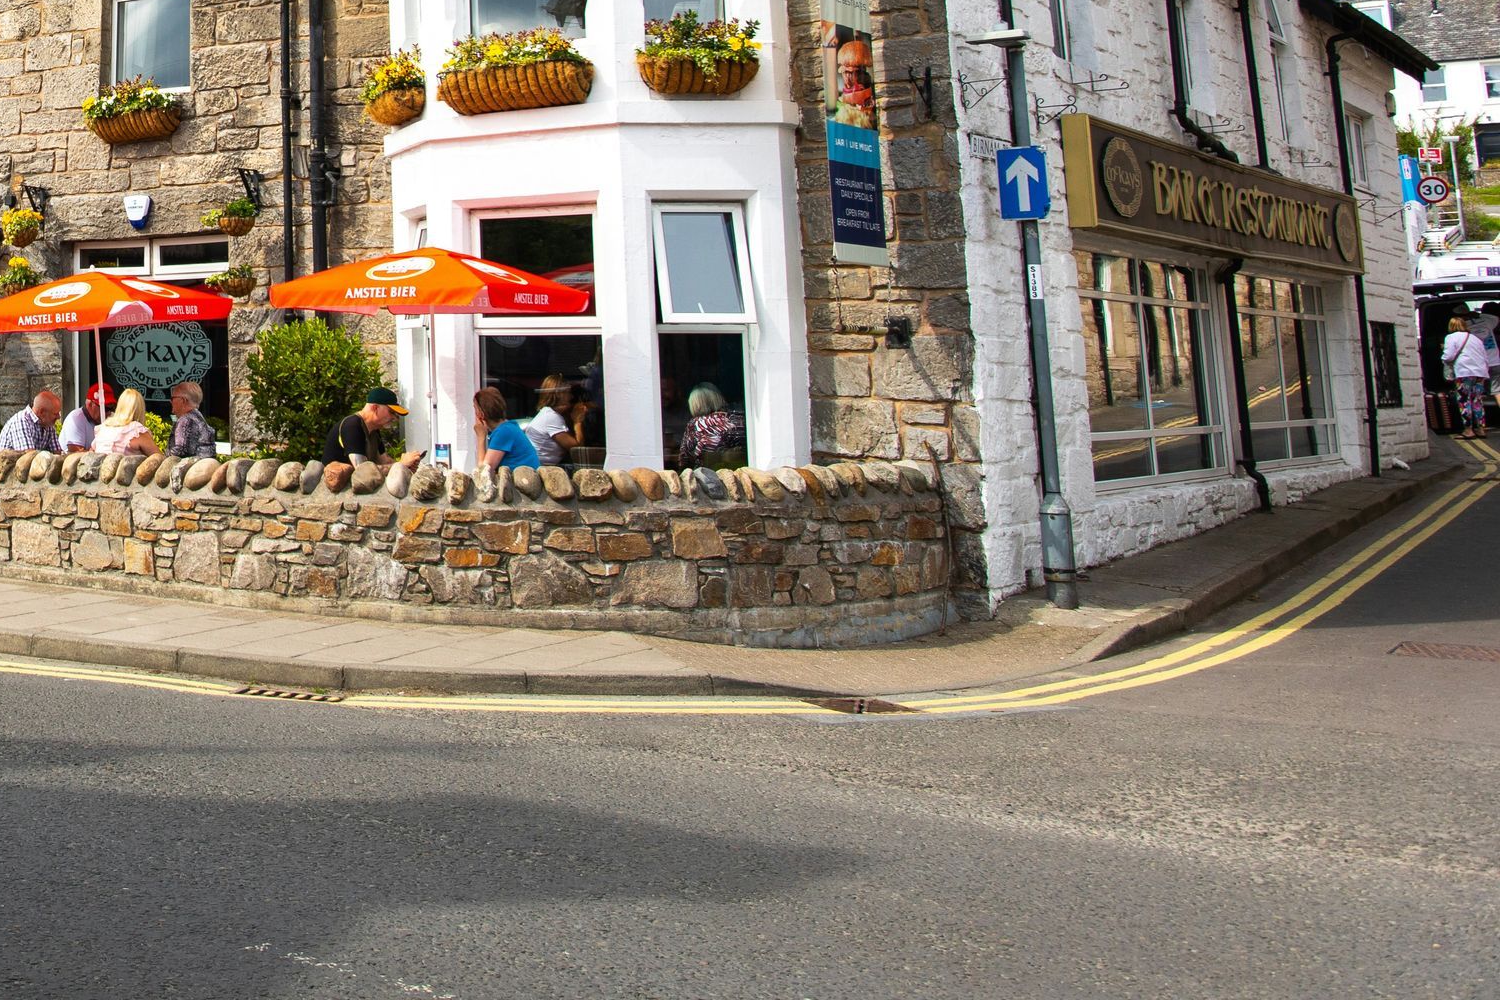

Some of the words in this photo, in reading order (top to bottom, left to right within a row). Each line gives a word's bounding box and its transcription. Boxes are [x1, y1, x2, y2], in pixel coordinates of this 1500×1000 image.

[835, 178, 863, 189] RESTAURANT
[841, 190, 853, 199] DAILY
[854, 192, 873, 202] SPECIALS
[1150, 160, 1200, 222] BAR
[1422, 184, 1445, 196] 30
[845, 208, 857, 217] OPEN
[837, 218, 862, 229] BREAKFAST
[345, 288, 387, 299] AMSTEL
[390, 286, 417, 298] BIER
[514, 293, 533, 304] AMSTEL
[534, 294, 549, 305] BIER
[167, 305, 184, 315] AMSTEL
[185, 305, 199, 315] BIER
[17, 314, 53, 327] AMSTEL
[55, 312, 78, 323] BIER
[128, 322, 189, 343] RESTAURANT
[132, 366, 164, 387] HOTEL
[165, 367, 186, 385] BAR
